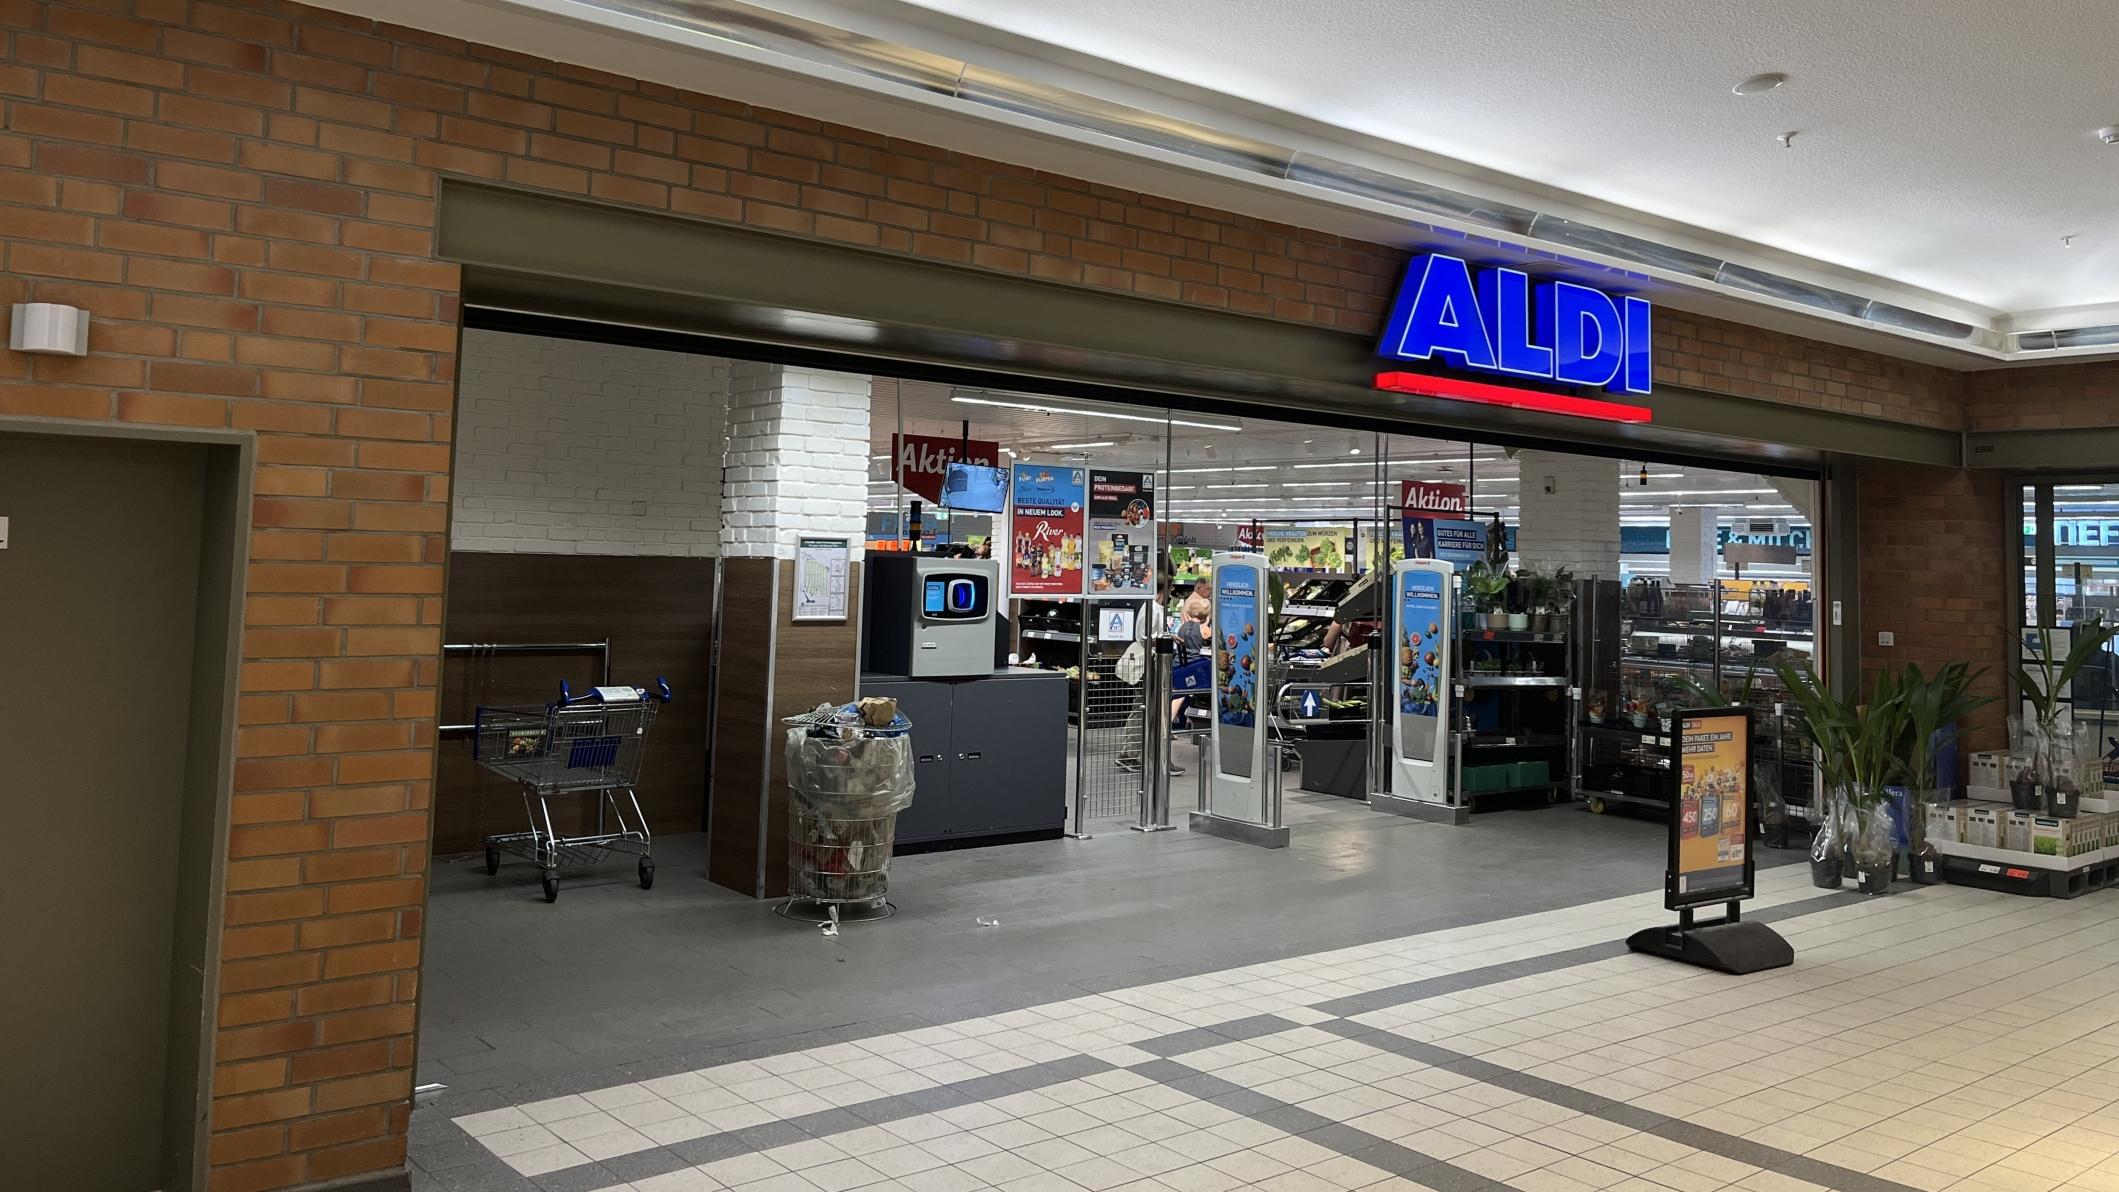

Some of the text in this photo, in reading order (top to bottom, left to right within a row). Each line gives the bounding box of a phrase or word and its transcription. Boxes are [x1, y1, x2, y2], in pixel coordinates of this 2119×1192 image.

[1388, 252, 1652, 395] ALDI
[1404, 486, 1463, 511] Aktion
[1025, 508, 1046, 516] NEUEM
[1032, 520, 1065, 542] River
[1454, 530, 1464, 538] FÜR
[1438, 540, 1462, 548] KARRIERE
[1682, 735, 1694, 743] DEIN
[1682, 745, 1696, 753] MEHR
[1682, 810, 1697, 824] 450
[1703, 808, 1718, 821] 250
